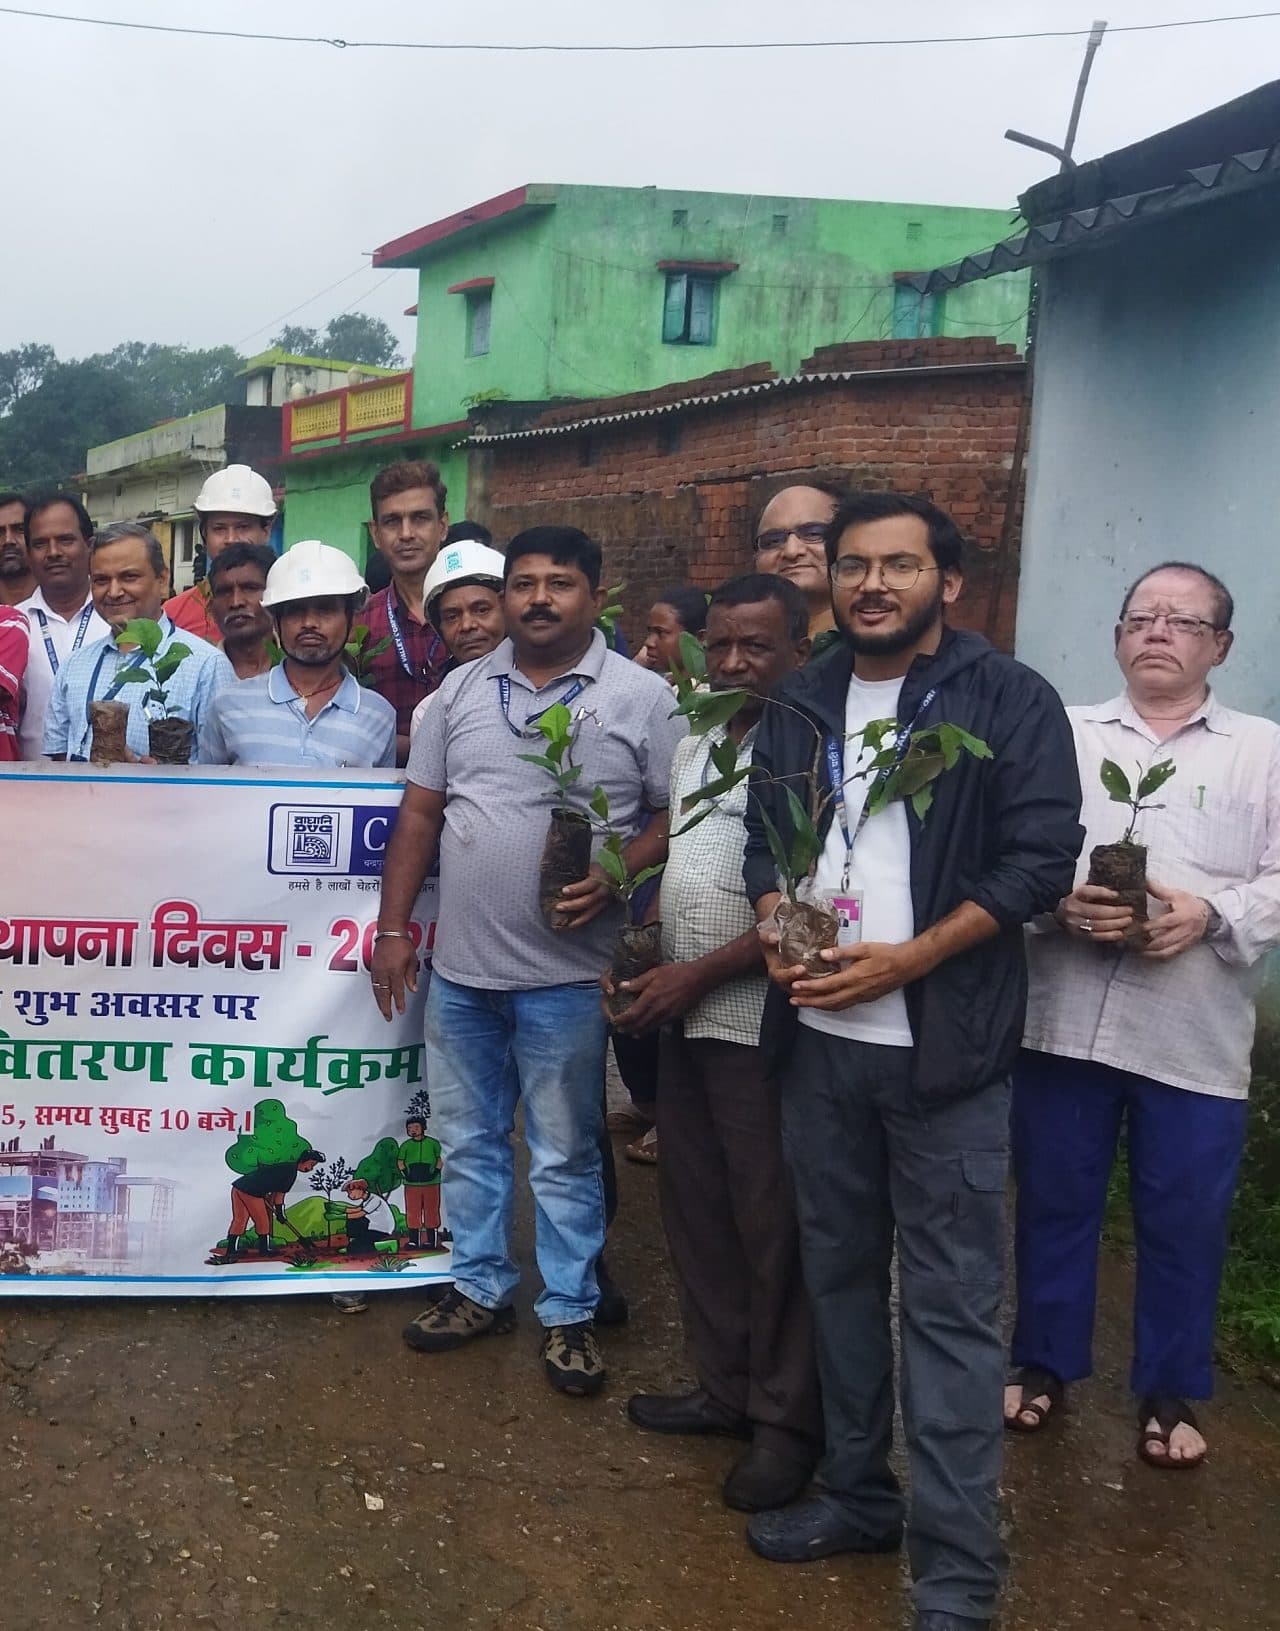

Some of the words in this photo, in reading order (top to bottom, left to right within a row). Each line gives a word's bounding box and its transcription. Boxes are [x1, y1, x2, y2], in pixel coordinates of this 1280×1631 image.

[288, 879, 310, 891] हमसे
[328, 879, 351, 891] लाखों
[357, 879, 380, 892] चेहरों
[151, 901, 288, 971] दिवस
[14, 990, 81, 1026] शुभ
[91, 992, 204, 1019] अवसर
[213, 994, 260, 1020] पर
[190, 1035, 425, 1096] कार्यक्रम
[35, 1106, 93, 1126] समय
[99, 1107, 152, 1135] सुबह
[160, 1109, 189, 1130] 10
